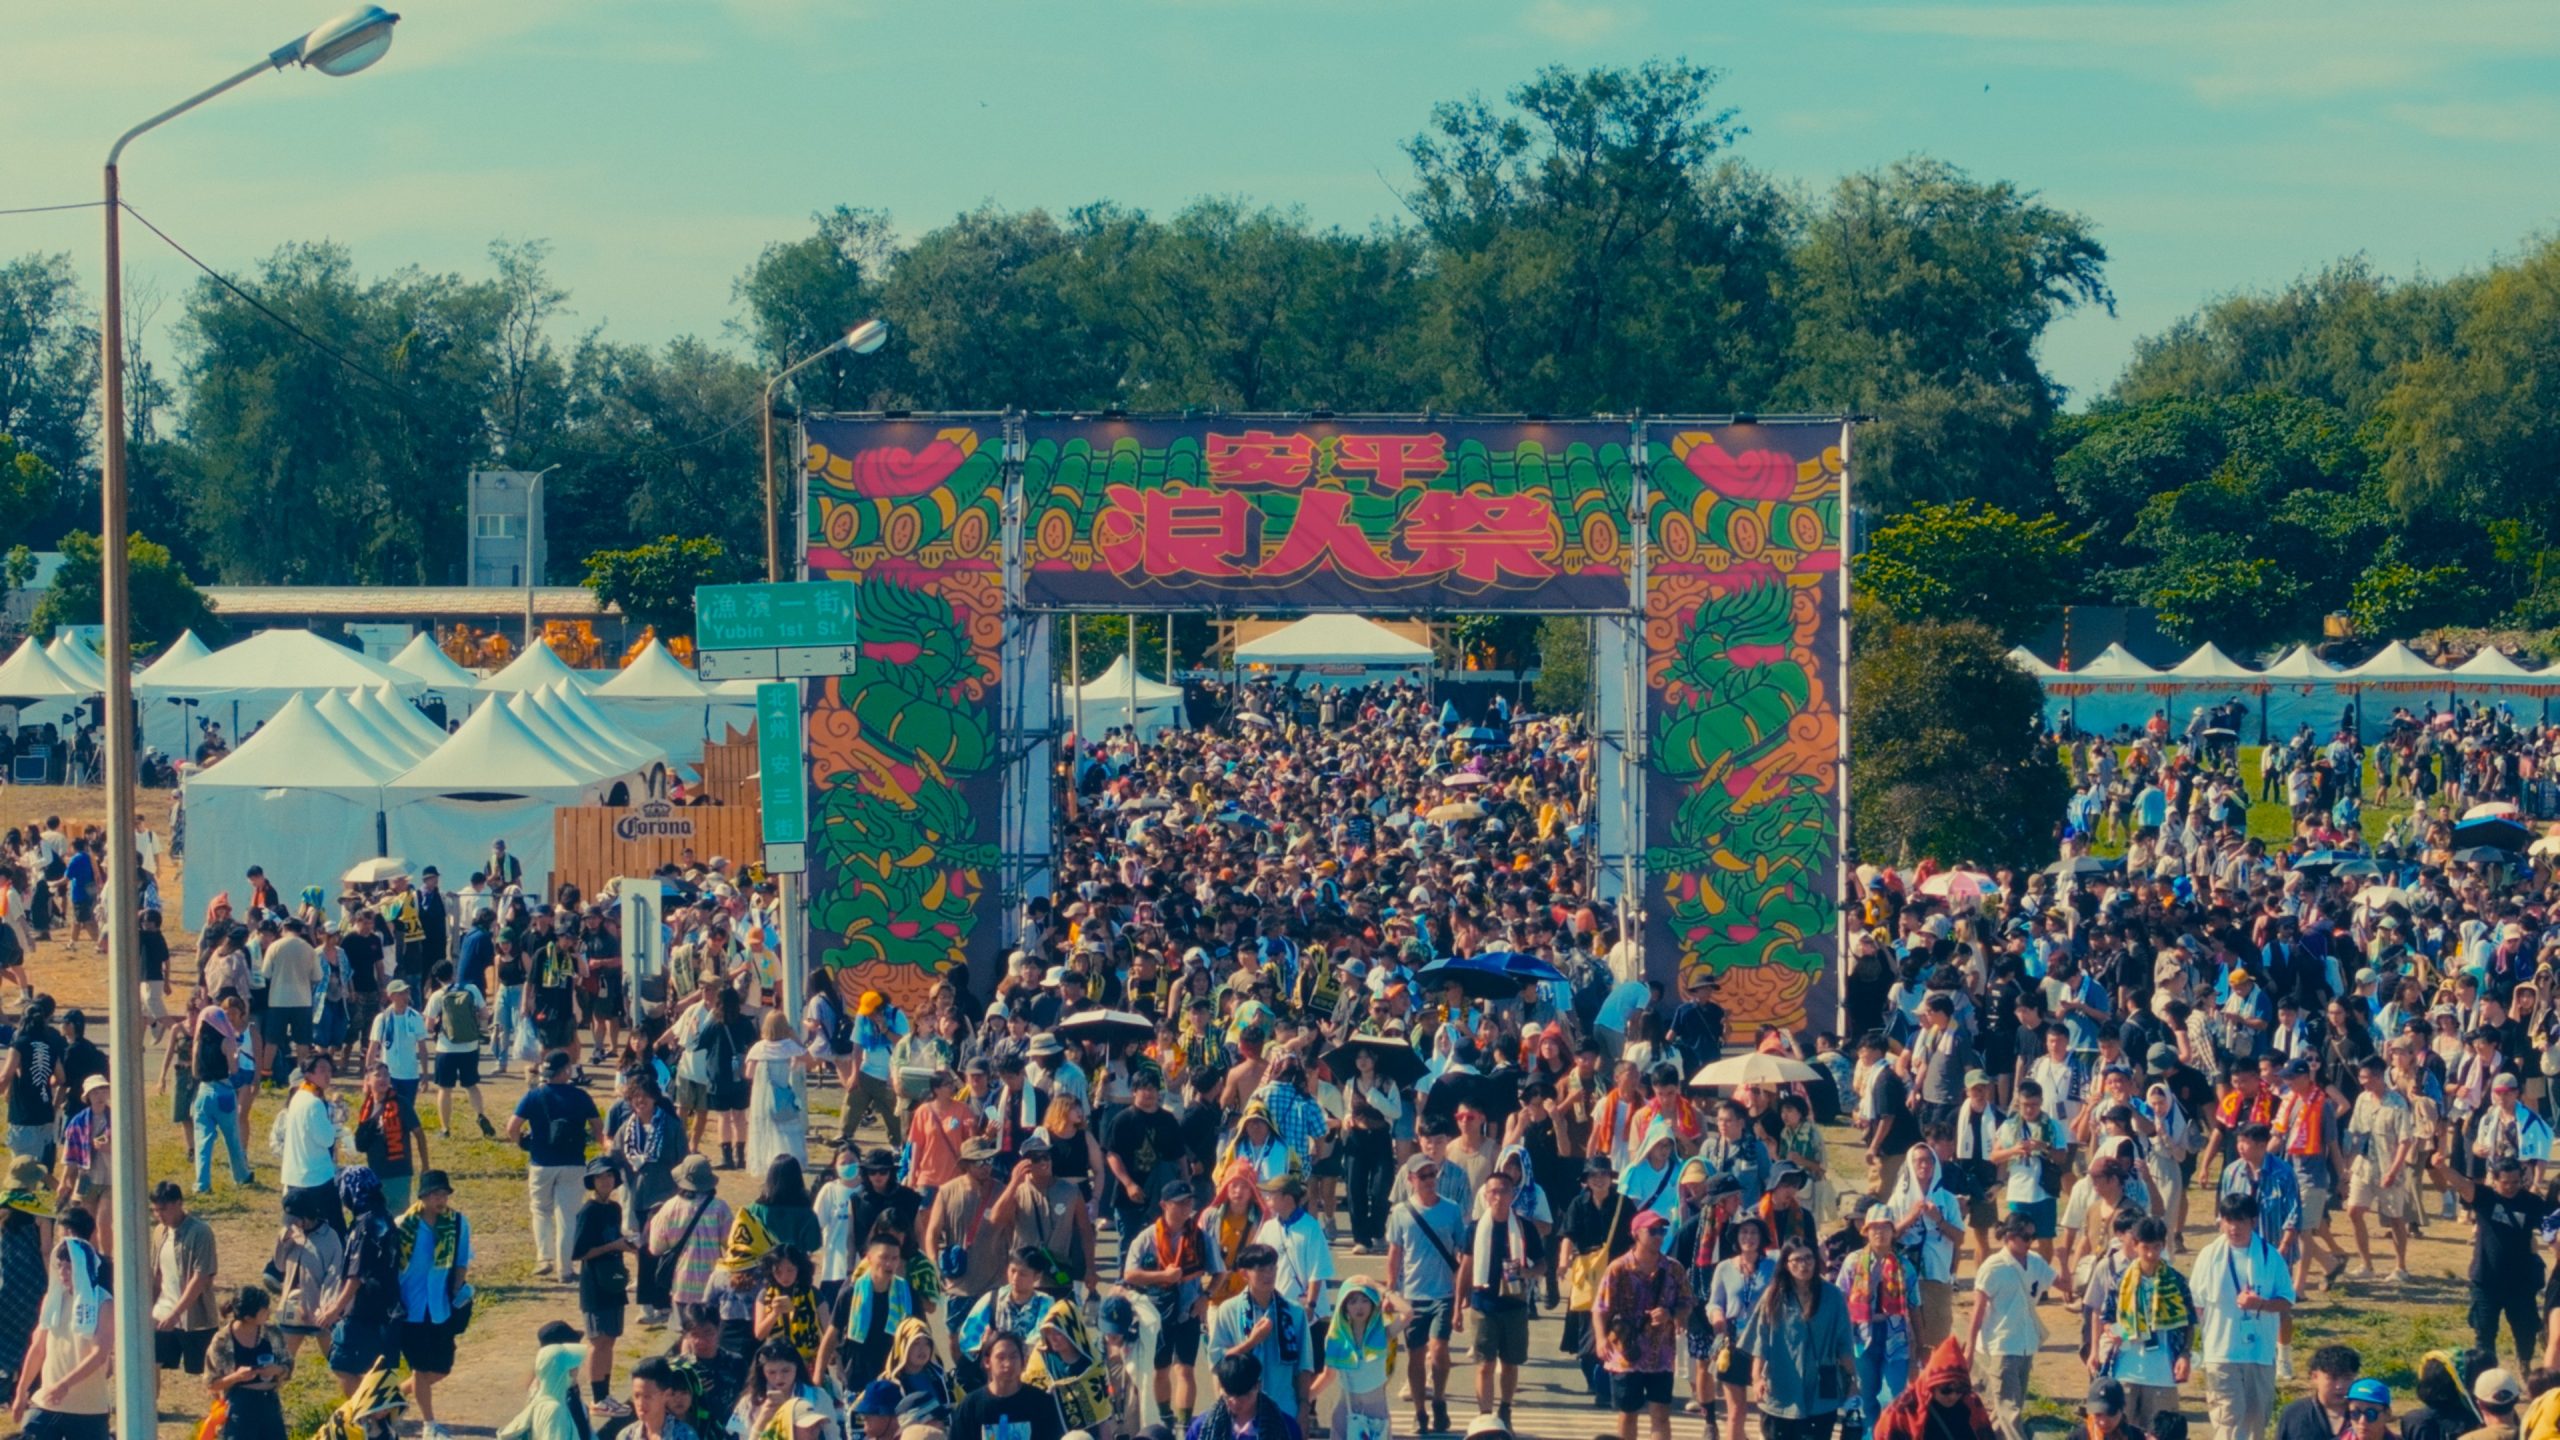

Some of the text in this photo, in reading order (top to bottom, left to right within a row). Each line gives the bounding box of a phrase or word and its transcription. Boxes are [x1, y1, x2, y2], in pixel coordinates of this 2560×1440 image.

[1206, 430, 1449, 494] 安平
[1101, 485, 1557, 582] 浪人祭
[712, 590, 841, 618] 漁濱一街
[713, 620, 842, 639] Yubin 1st St.
[768, 689, 787, 708] 北
[617, 816, 691, 841] Corona
